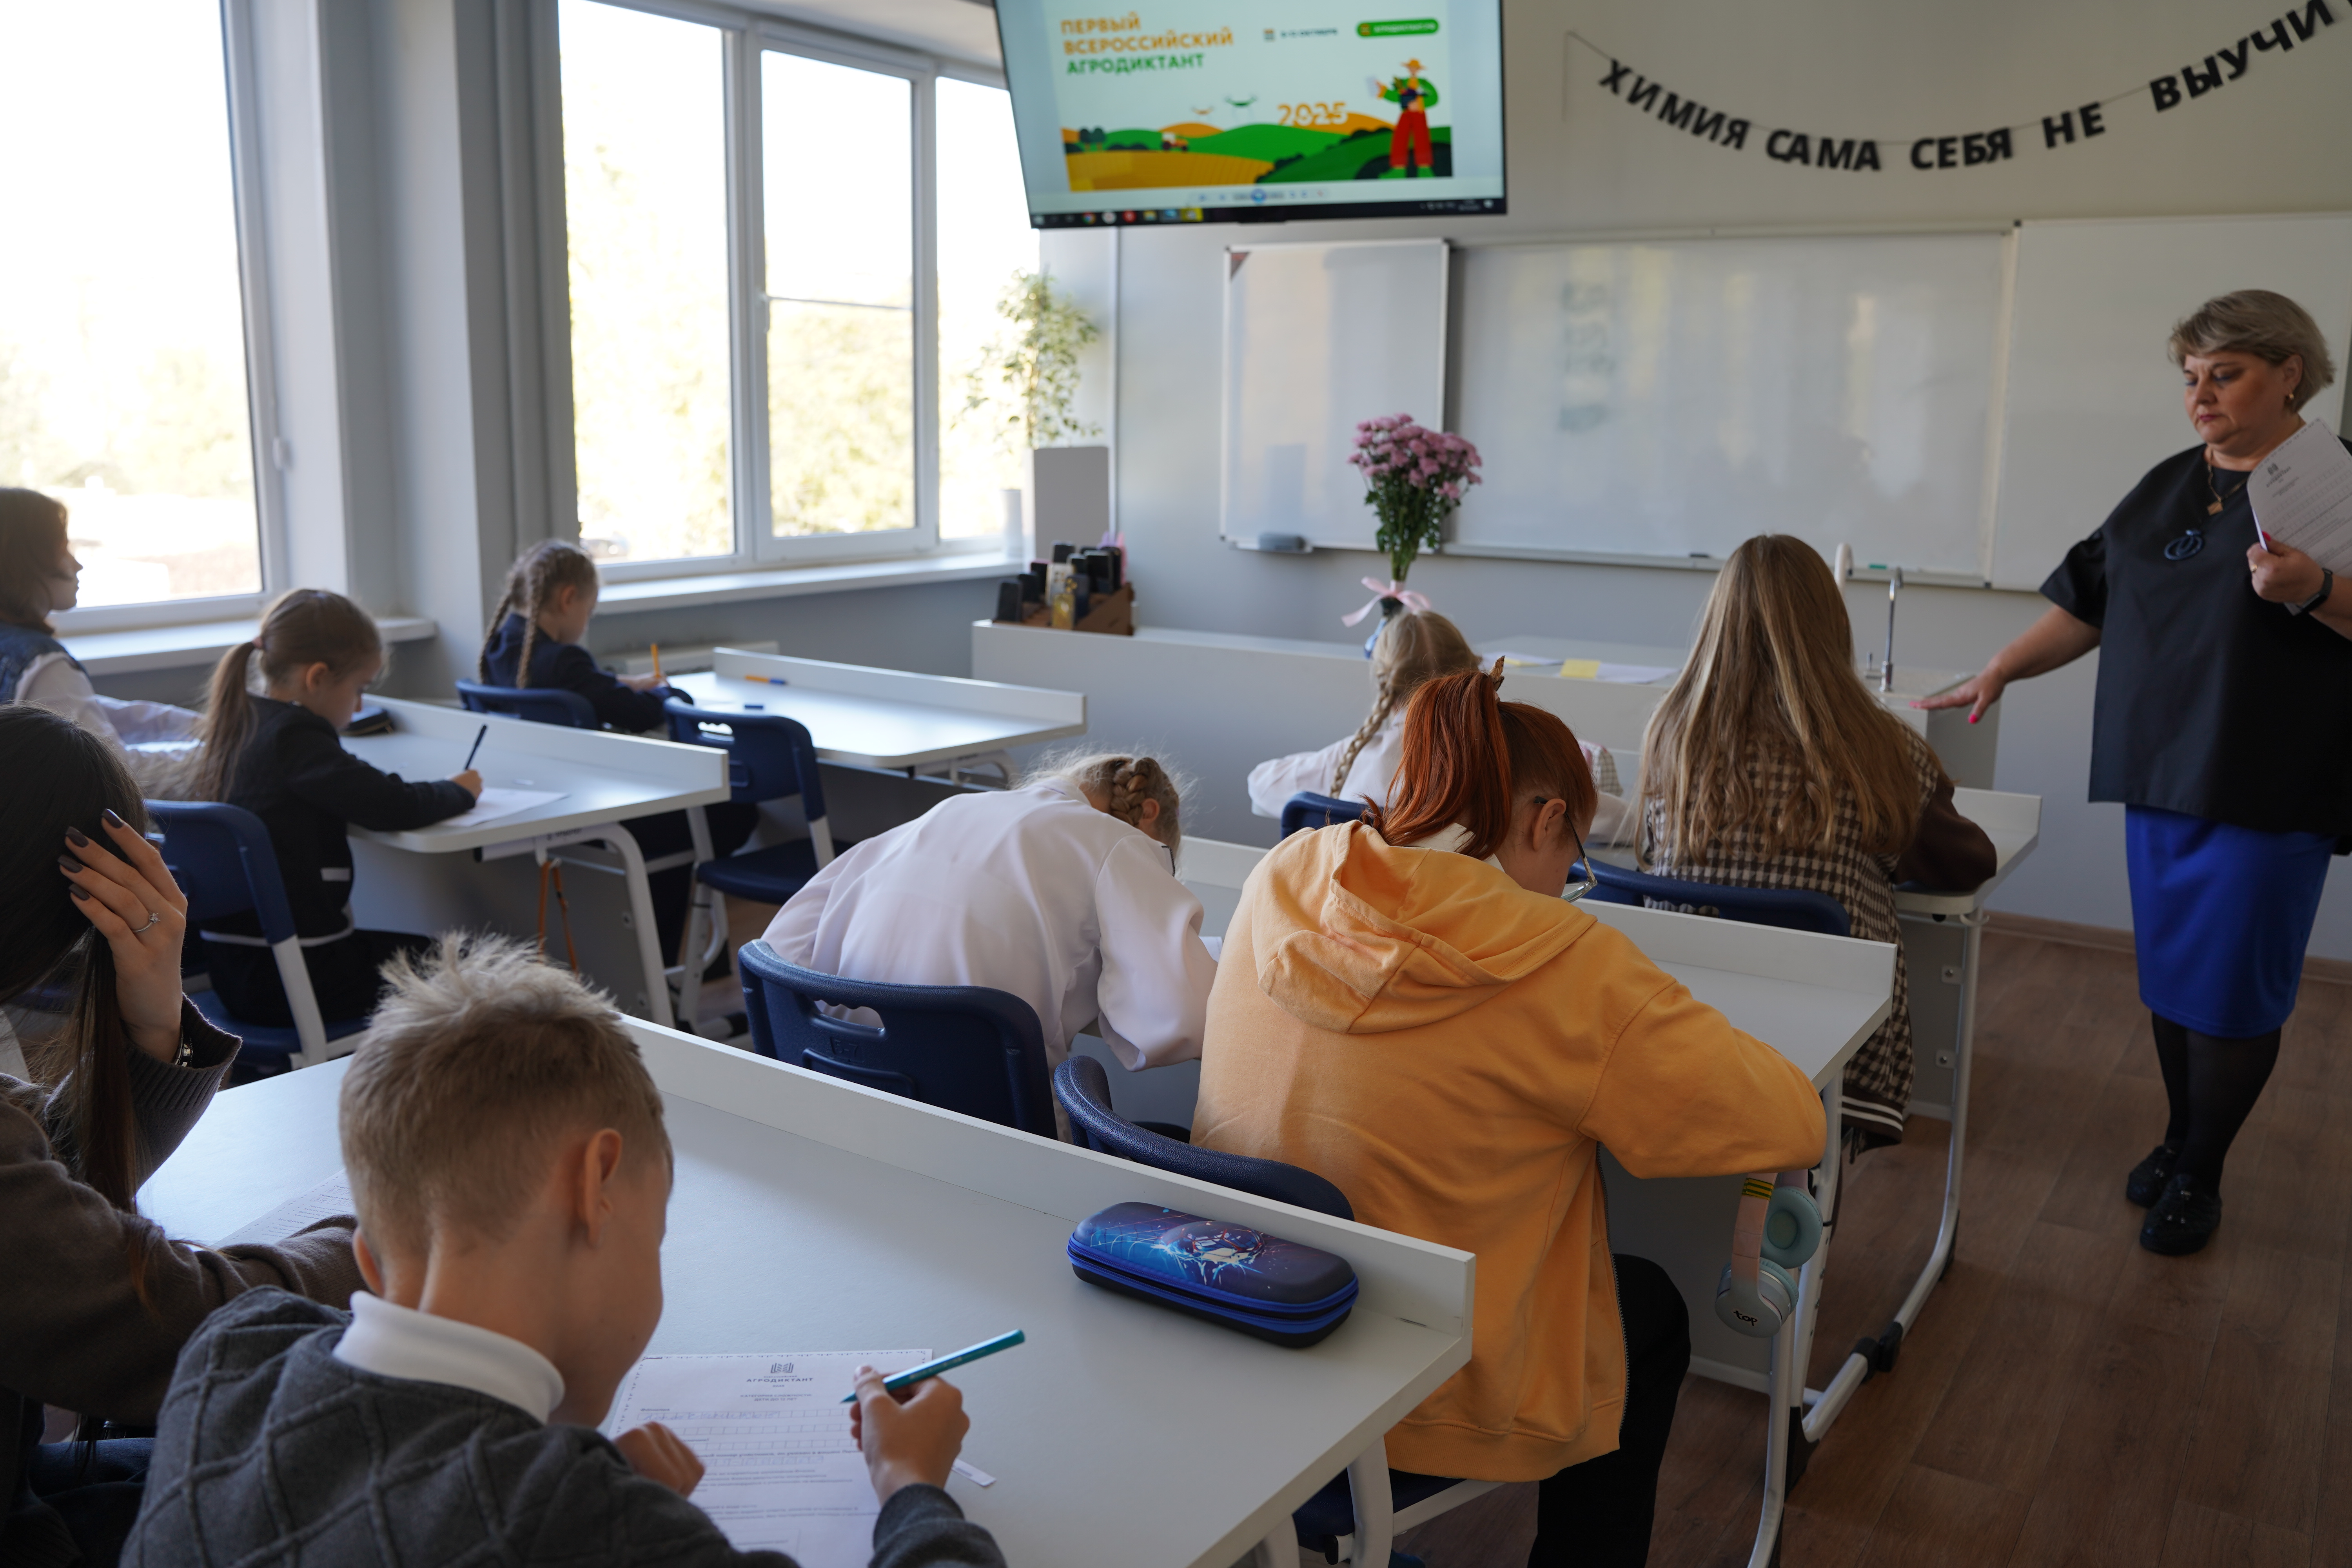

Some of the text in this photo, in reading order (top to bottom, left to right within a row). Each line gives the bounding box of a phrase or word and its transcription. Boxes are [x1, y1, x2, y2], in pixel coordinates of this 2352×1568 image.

[1061, 11, 1140, 34] ПЕРВЫЙ
[1064, 26, 1233, 54] ВСЕРОССИЙСКИЙ
[1067, 54, 1203, 73] АГРОДИКТАНТ
[1599, 0, 2352, 172] ХИМИЯ САМА СЕБЯ НЕ ВЫУЧИ
[1278, 101, 1348, 126] 2025
[1733, 1310, 1757, 1326] top
